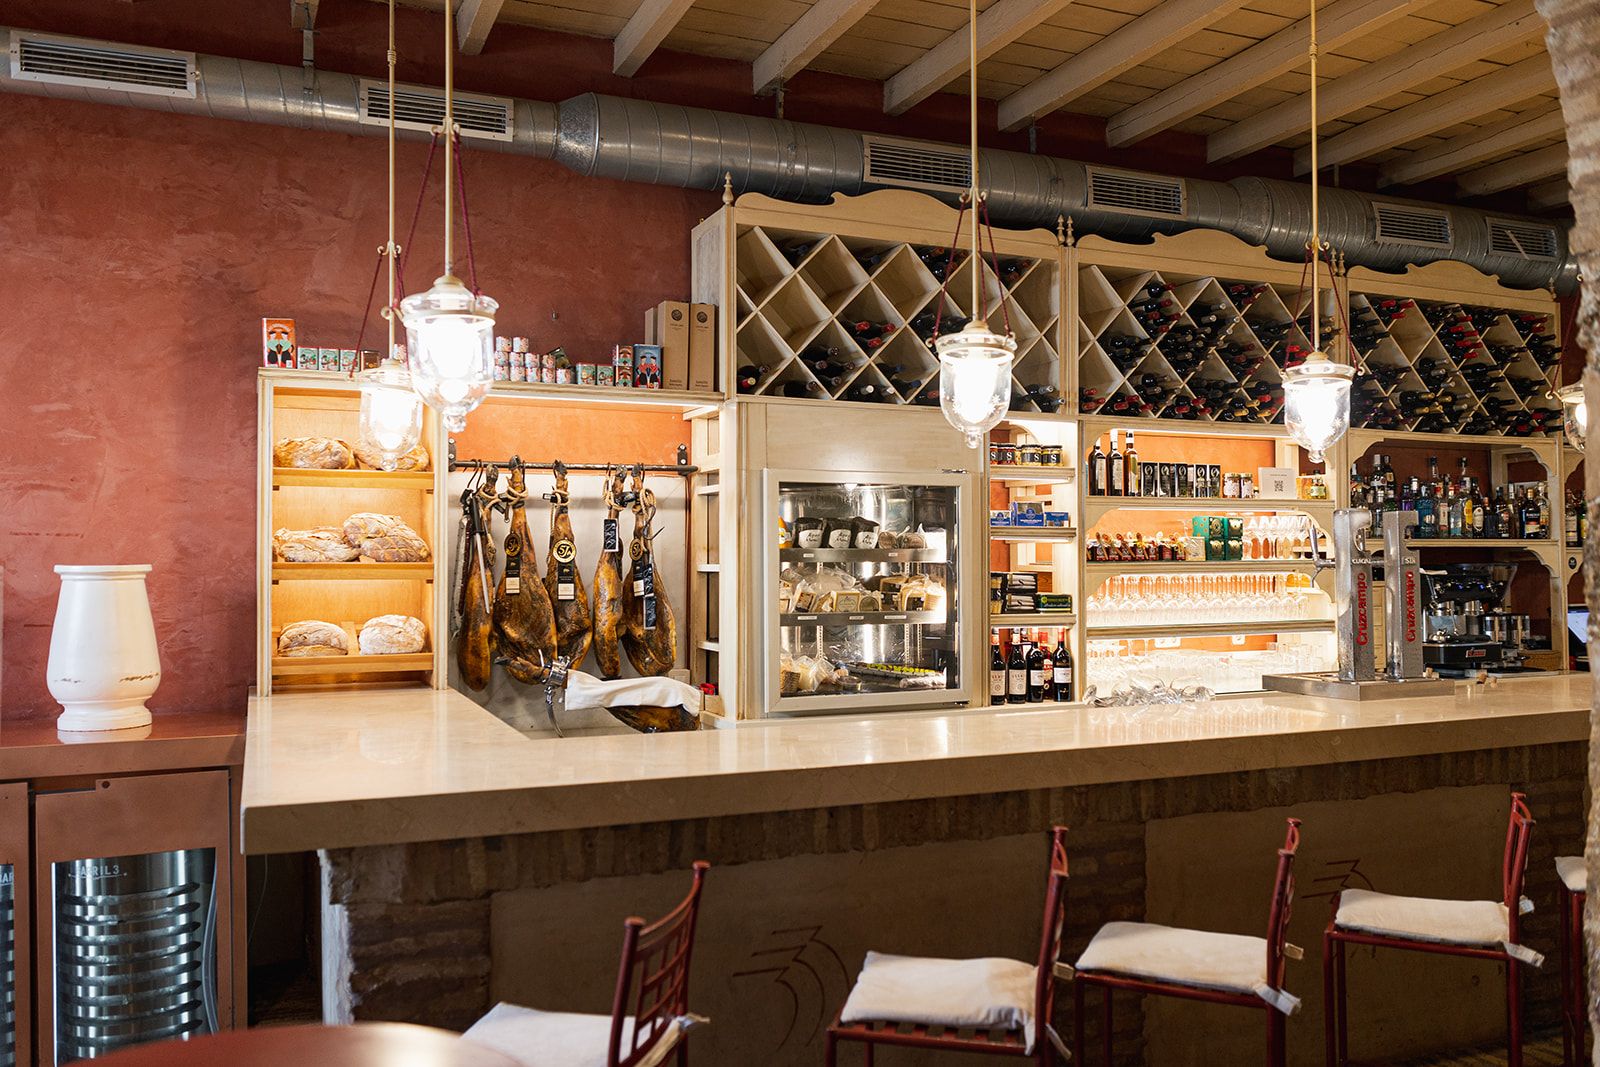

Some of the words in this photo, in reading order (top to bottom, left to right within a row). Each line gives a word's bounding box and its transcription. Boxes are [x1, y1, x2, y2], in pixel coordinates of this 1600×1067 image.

[1006, 452, 1013, 460] S
[1356, 572, 1368, 646] Cruzcampo
[1405, 570, 1416, 643] Cruzcampo
[75, 865, 111, 876] ARIL
[113, 864, 120, 874] 3
